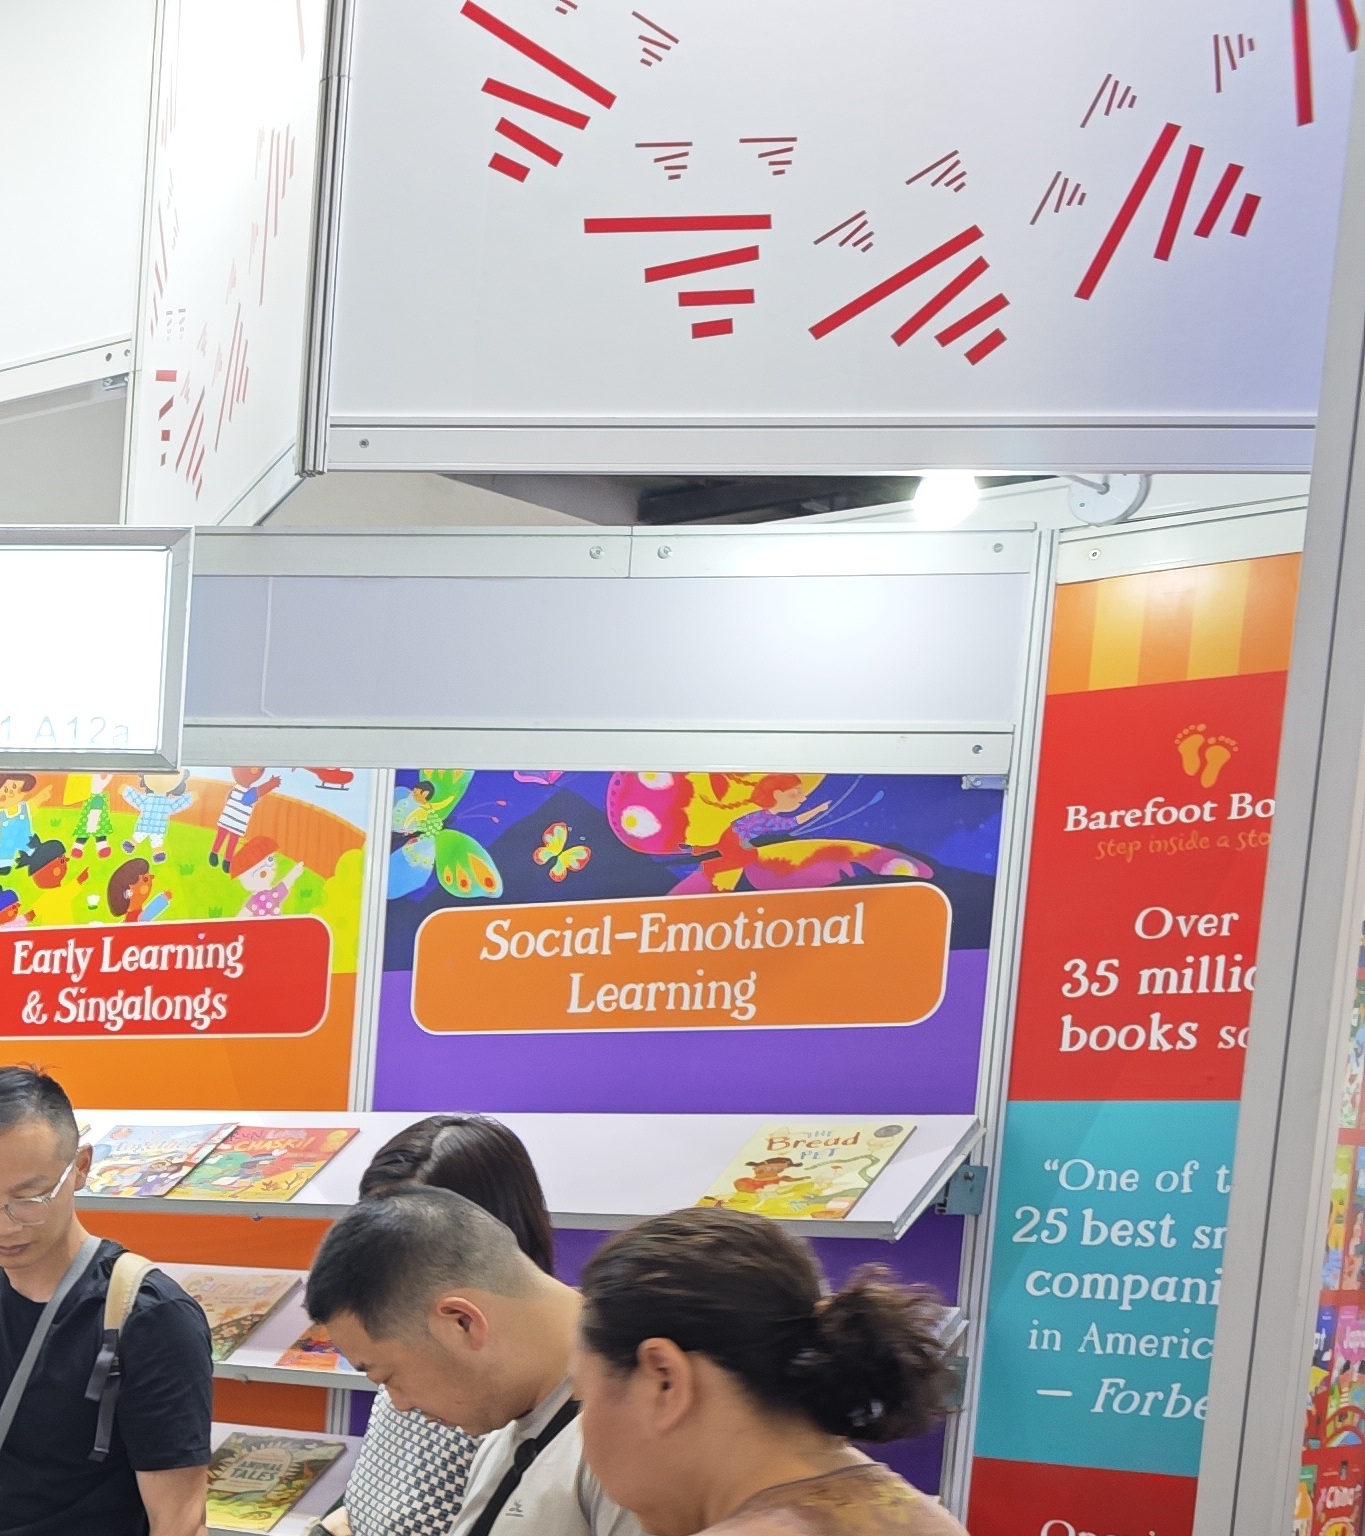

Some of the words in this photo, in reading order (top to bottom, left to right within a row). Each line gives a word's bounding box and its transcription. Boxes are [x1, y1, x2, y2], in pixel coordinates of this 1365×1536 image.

[32, 714, 131, 747] A12a
[1063, 796, 1217, 833] Barefoot
[1095, 838, 1142, 863] step
[1148, 830, 1210, 855] inside
[1217, 834, 1230, 848] a
[479, 901, 866, 961] Social-Emotional
[1134, 906, 1240, 940] Over
[12, 937, 95, 983] Early
[99, 933, 245, 979] Learning
[566, 969, 758, 1020] Learning
[1060, 957, 1120, 999] 35
[21, 989, 49, 1025] &
[54, 984, 228, 1032] Singalongs
[1059, 1012, 1199, 1053] books
[766, 1132, 861, 1151] Bread
[1154, 1159, 1200, 1194] of
[1011, 1205, 1069, 1245] 25
[1080, 1207, 1177, 1249] best
[1027, 1319, 1062, 1352] in
[229, 1468, 281, 1482] TALES
